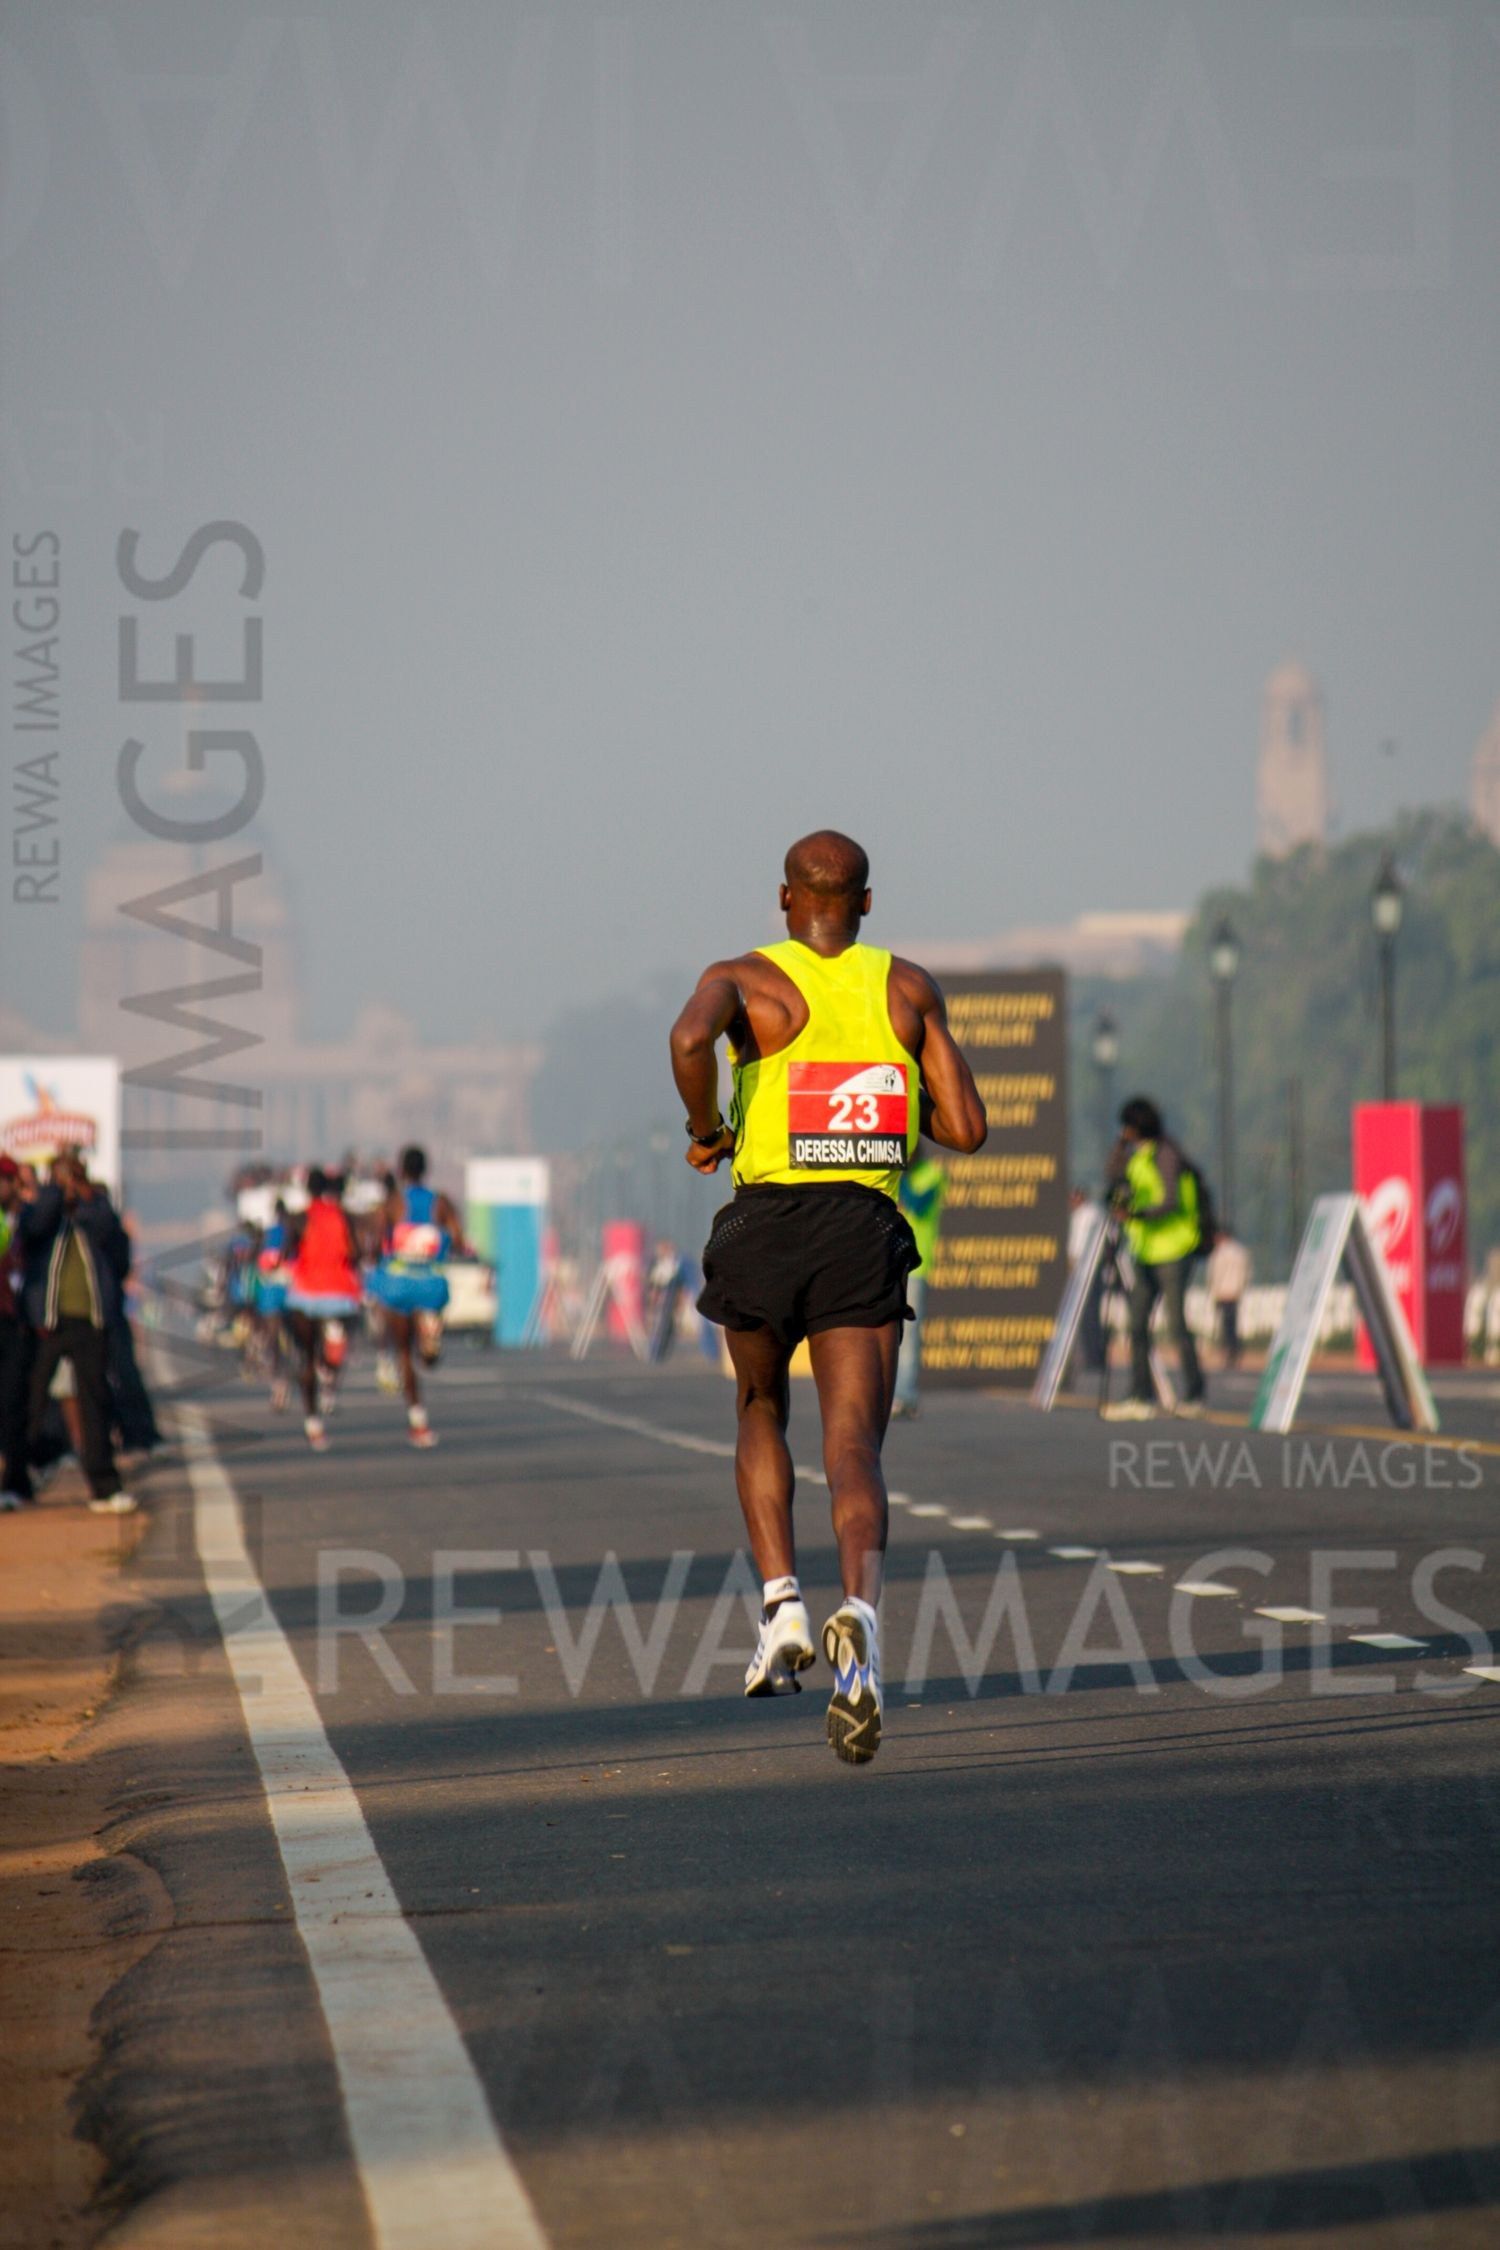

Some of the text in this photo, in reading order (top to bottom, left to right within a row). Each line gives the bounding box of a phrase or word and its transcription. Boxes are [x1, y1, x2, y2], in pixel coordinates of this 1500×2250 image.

[827, 1094, 880, 1131] 23
[795, 1138, 903, 1164] DERESSA CHIMSA
